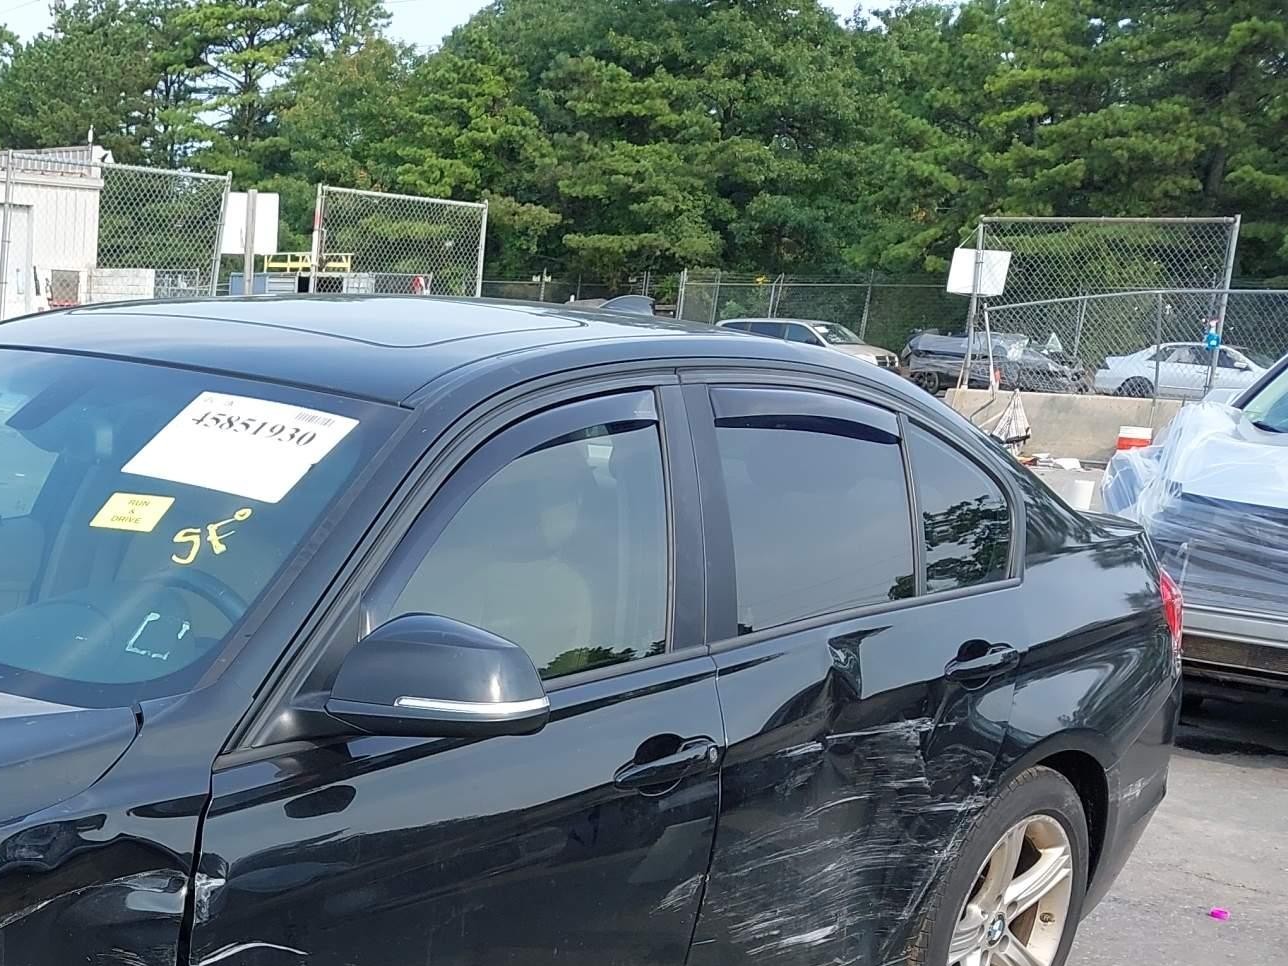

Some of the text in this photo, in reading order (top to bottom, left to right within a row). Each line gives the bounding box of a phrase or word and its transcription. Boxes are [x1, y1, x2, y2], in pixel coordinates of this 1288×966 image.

[192, 411, 317, 447] 45851930
[127, 499, 151, 507] RUN
[110, 515, 143, 524] DRIVE
